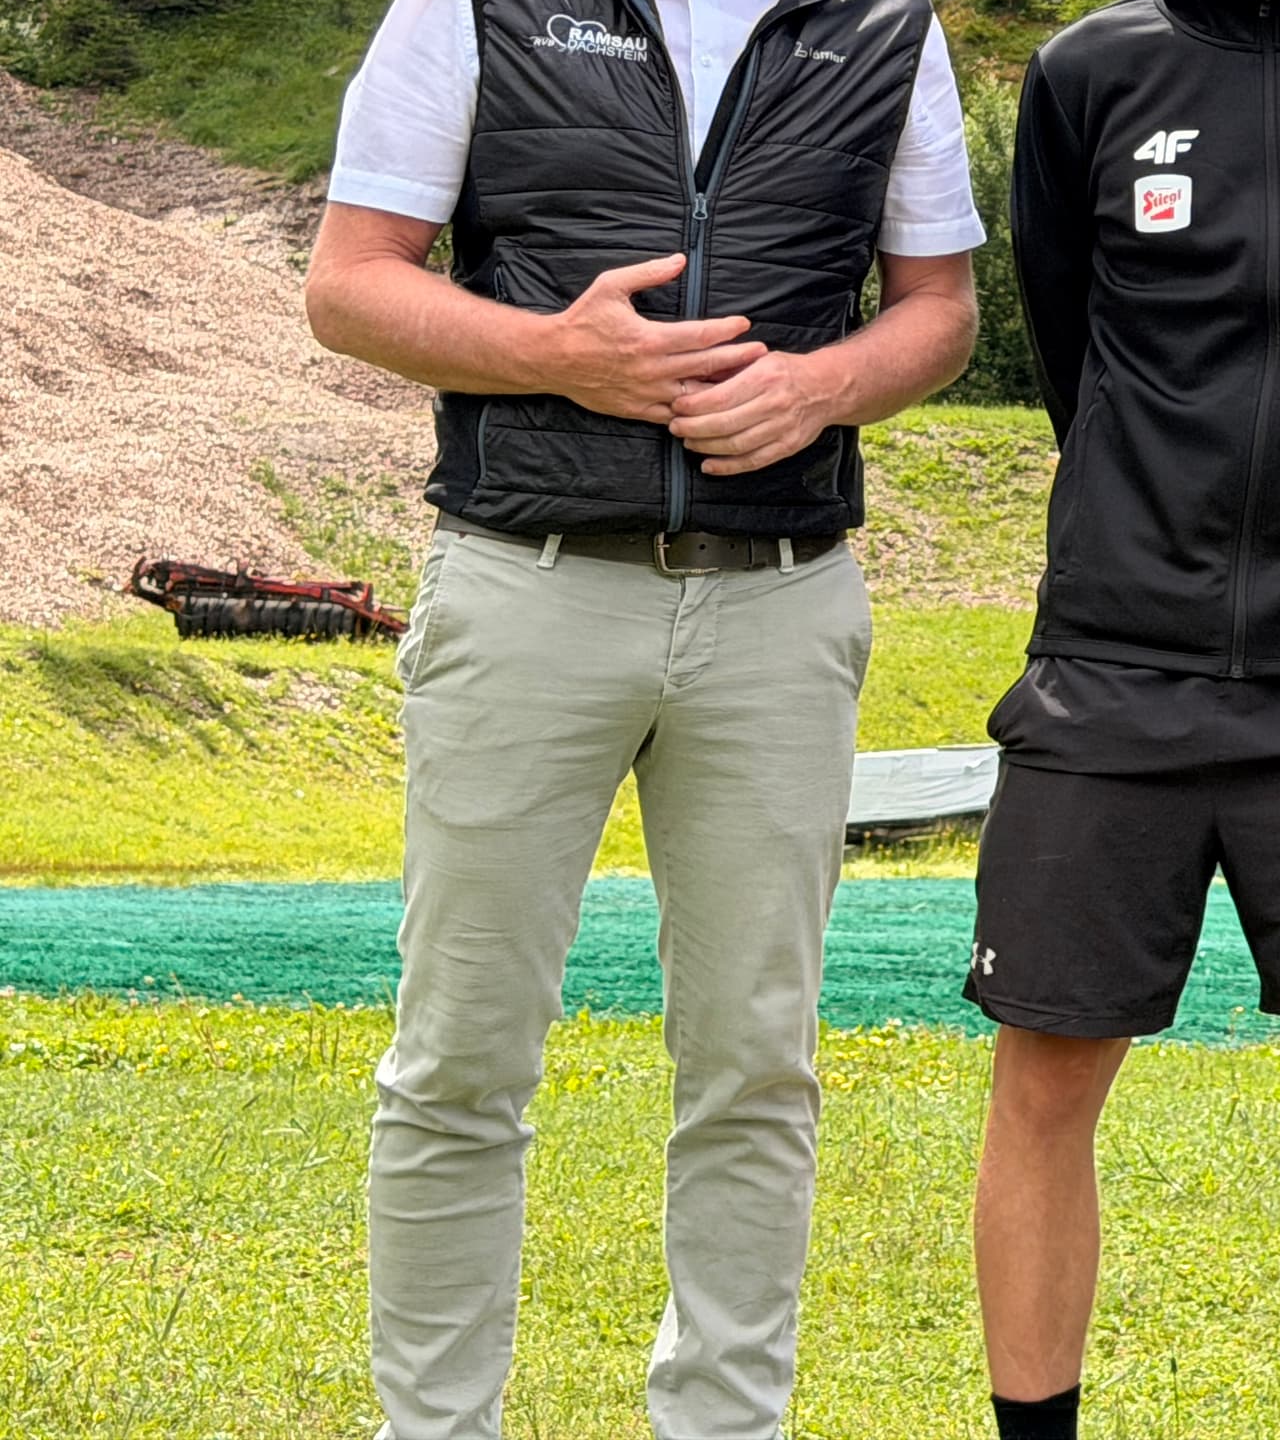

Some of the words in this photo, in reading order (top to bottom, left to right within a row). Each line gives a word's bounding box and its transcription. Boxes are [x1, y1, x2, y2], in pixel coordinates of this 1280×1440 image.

[567, 39, 648, 62] DACHSTEIN
[568, 26, 648, 51] RAMSAU
[1133, 129, 1200, 164] 4F
